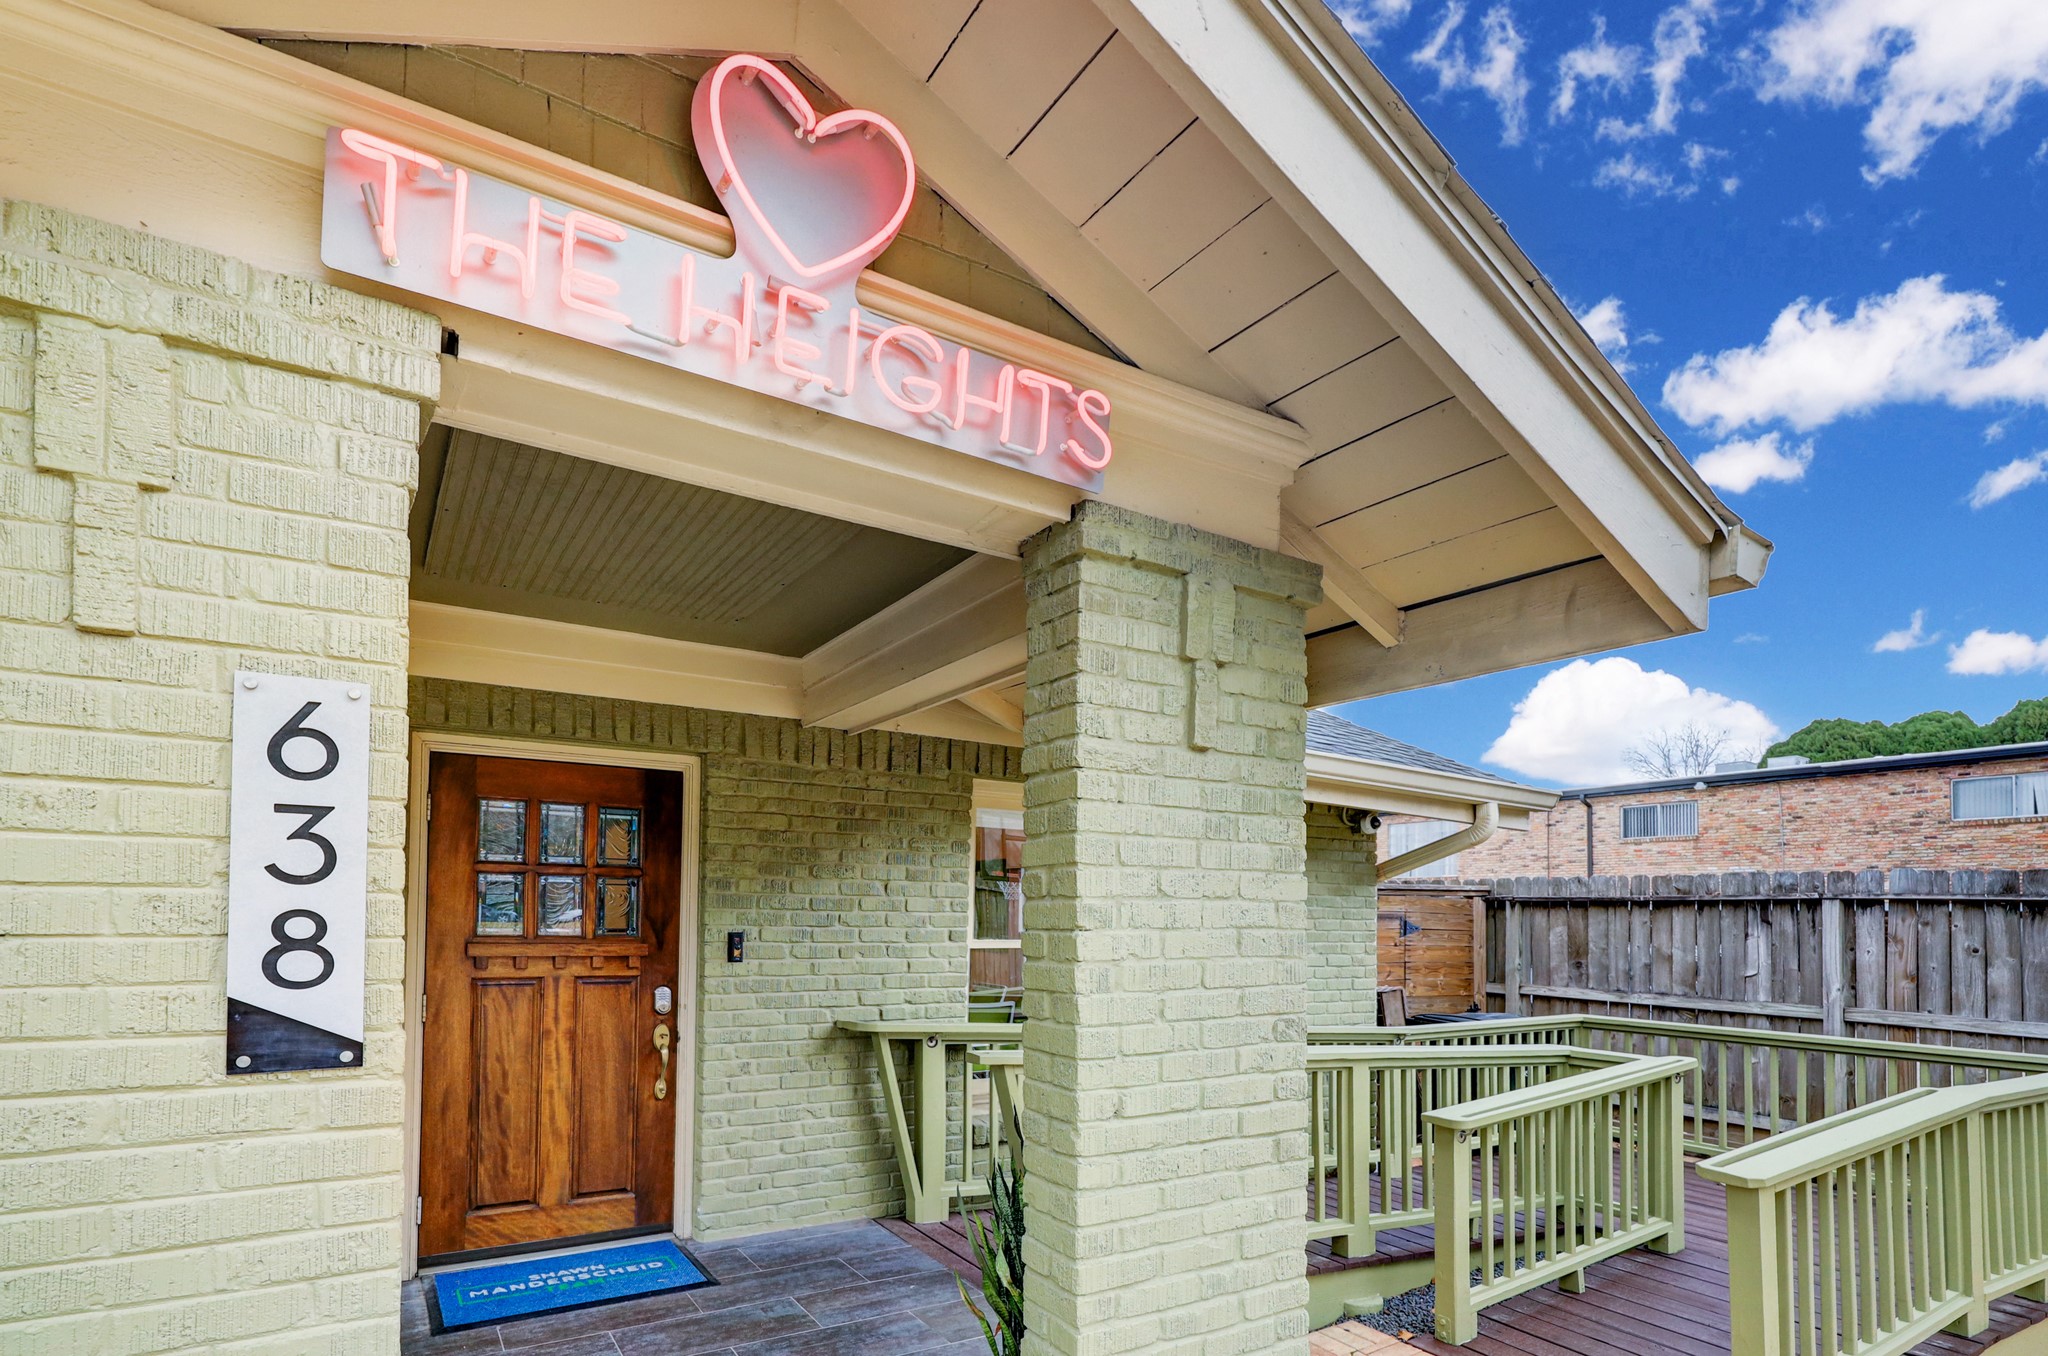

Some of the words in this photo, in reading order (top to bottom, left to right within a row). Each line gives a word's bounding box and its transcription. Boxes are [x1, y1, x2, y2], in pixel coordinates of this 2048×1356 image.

[340, 128, 628, 325] THE
[678, 253, 1113, 471] HEIGHTS
[261, 701, 340, 990] 638
[469, 1261, 664, 1298] MANDERSCHEID
[528, 1264, 605, 1281] SHAWN
